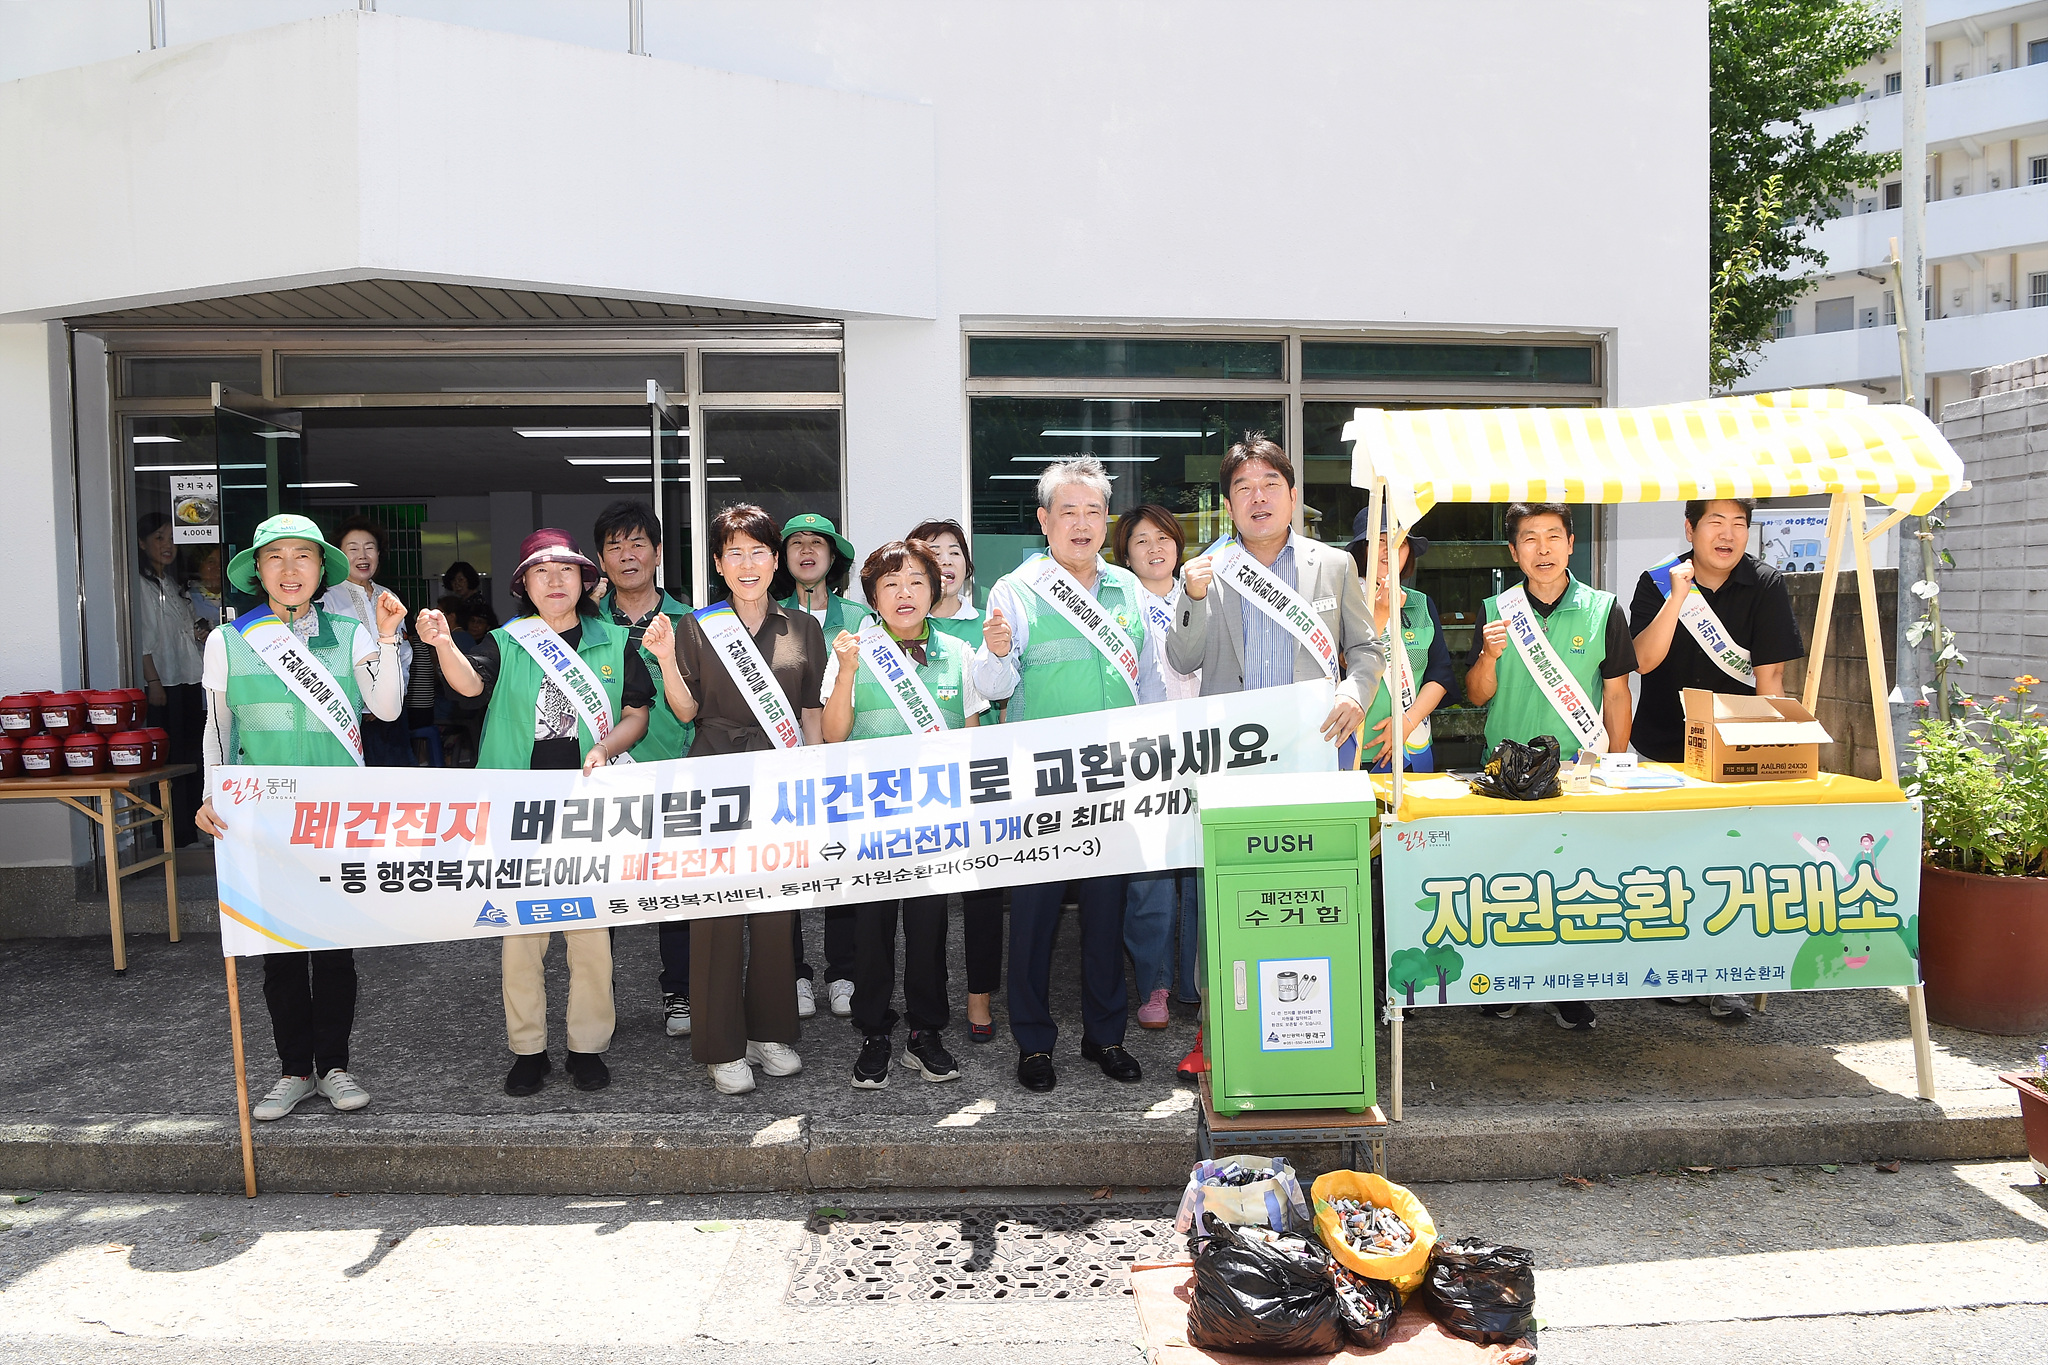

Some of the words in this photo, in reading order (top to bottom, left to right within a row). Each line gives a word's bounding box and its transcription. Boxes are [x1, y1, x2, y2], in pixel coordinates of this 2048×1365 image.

[177, 482, 214, 490] 잔치국수
[1049, 579, 1103, 631] 자원순환으로
[1097, 625, 1124, 655] 우리의
[1236, 564, 1291, 613] 자원순환으로
[1286, 605, 1315, 634] 우리의
[1310, 628, 1333, 660] 미래를
[1511, 611, 1536, 647] 쓰레기를
[1527, 642, 1564, 688] 재활용하면
[1697, 619, 1727, 653] 쓰레기를
[278, 648, 334, 705] 자원순환으로
[326, 699, 352, 731] 우리의
[537, 639, 571, 672] 쓰레기를
[562, 667, 603, 714] 재활용하면
[726, 639, 769, 695] 자원순환으로
[758, 691, 785, 723] 우리의
[775, 718, 798, 748] 미래를
[872, 645, 904, 681] 쓰레기를
[894, 678, 934, 728] 재활용하면
[266, 779, 296, 794] 동래
[290, 801, 491, 849] 폐건전지
[511, 785, 751, 842] 버리지말고
[771, 757, 1013, 828] 새건전지로
[1035, 723, 1280, 797] 교환하세요.
[1761, 762, 1787, 770] AA(LR6)
[340, 862, 367, 893] 동
[377, 855, 610, 893] 행정복지센터에서
[621, 846, 736, 881] 폐건전지
[747, 840, 810, 873] 10개
[857, 820, 970, 861] 새건전지
[1072, 799, 1125, 828] 최대
[1134, 788, 1192, 818] 4개)
[1247, 834, 1314, 854] PUSH
[1428, 830, 1450, 843] 동래
[530, 900, 583, 921] 문의
[608, 899, 630, 914] 동
[780, 878, 842, 897] 동래구
[1261, 889, 1325, 905] 폐건전지
[1421, 864, 1694, 948] 자원순환
[1702, 861, 1902, 936] 거래소
[1493, 975, 1535, 991] 동래구
[1542, 972, 1629, 989] 새마을부녀회
[1666, 969, 1709, 985] 동래구
[1715, 965, 1786, 982] 자원순환과
